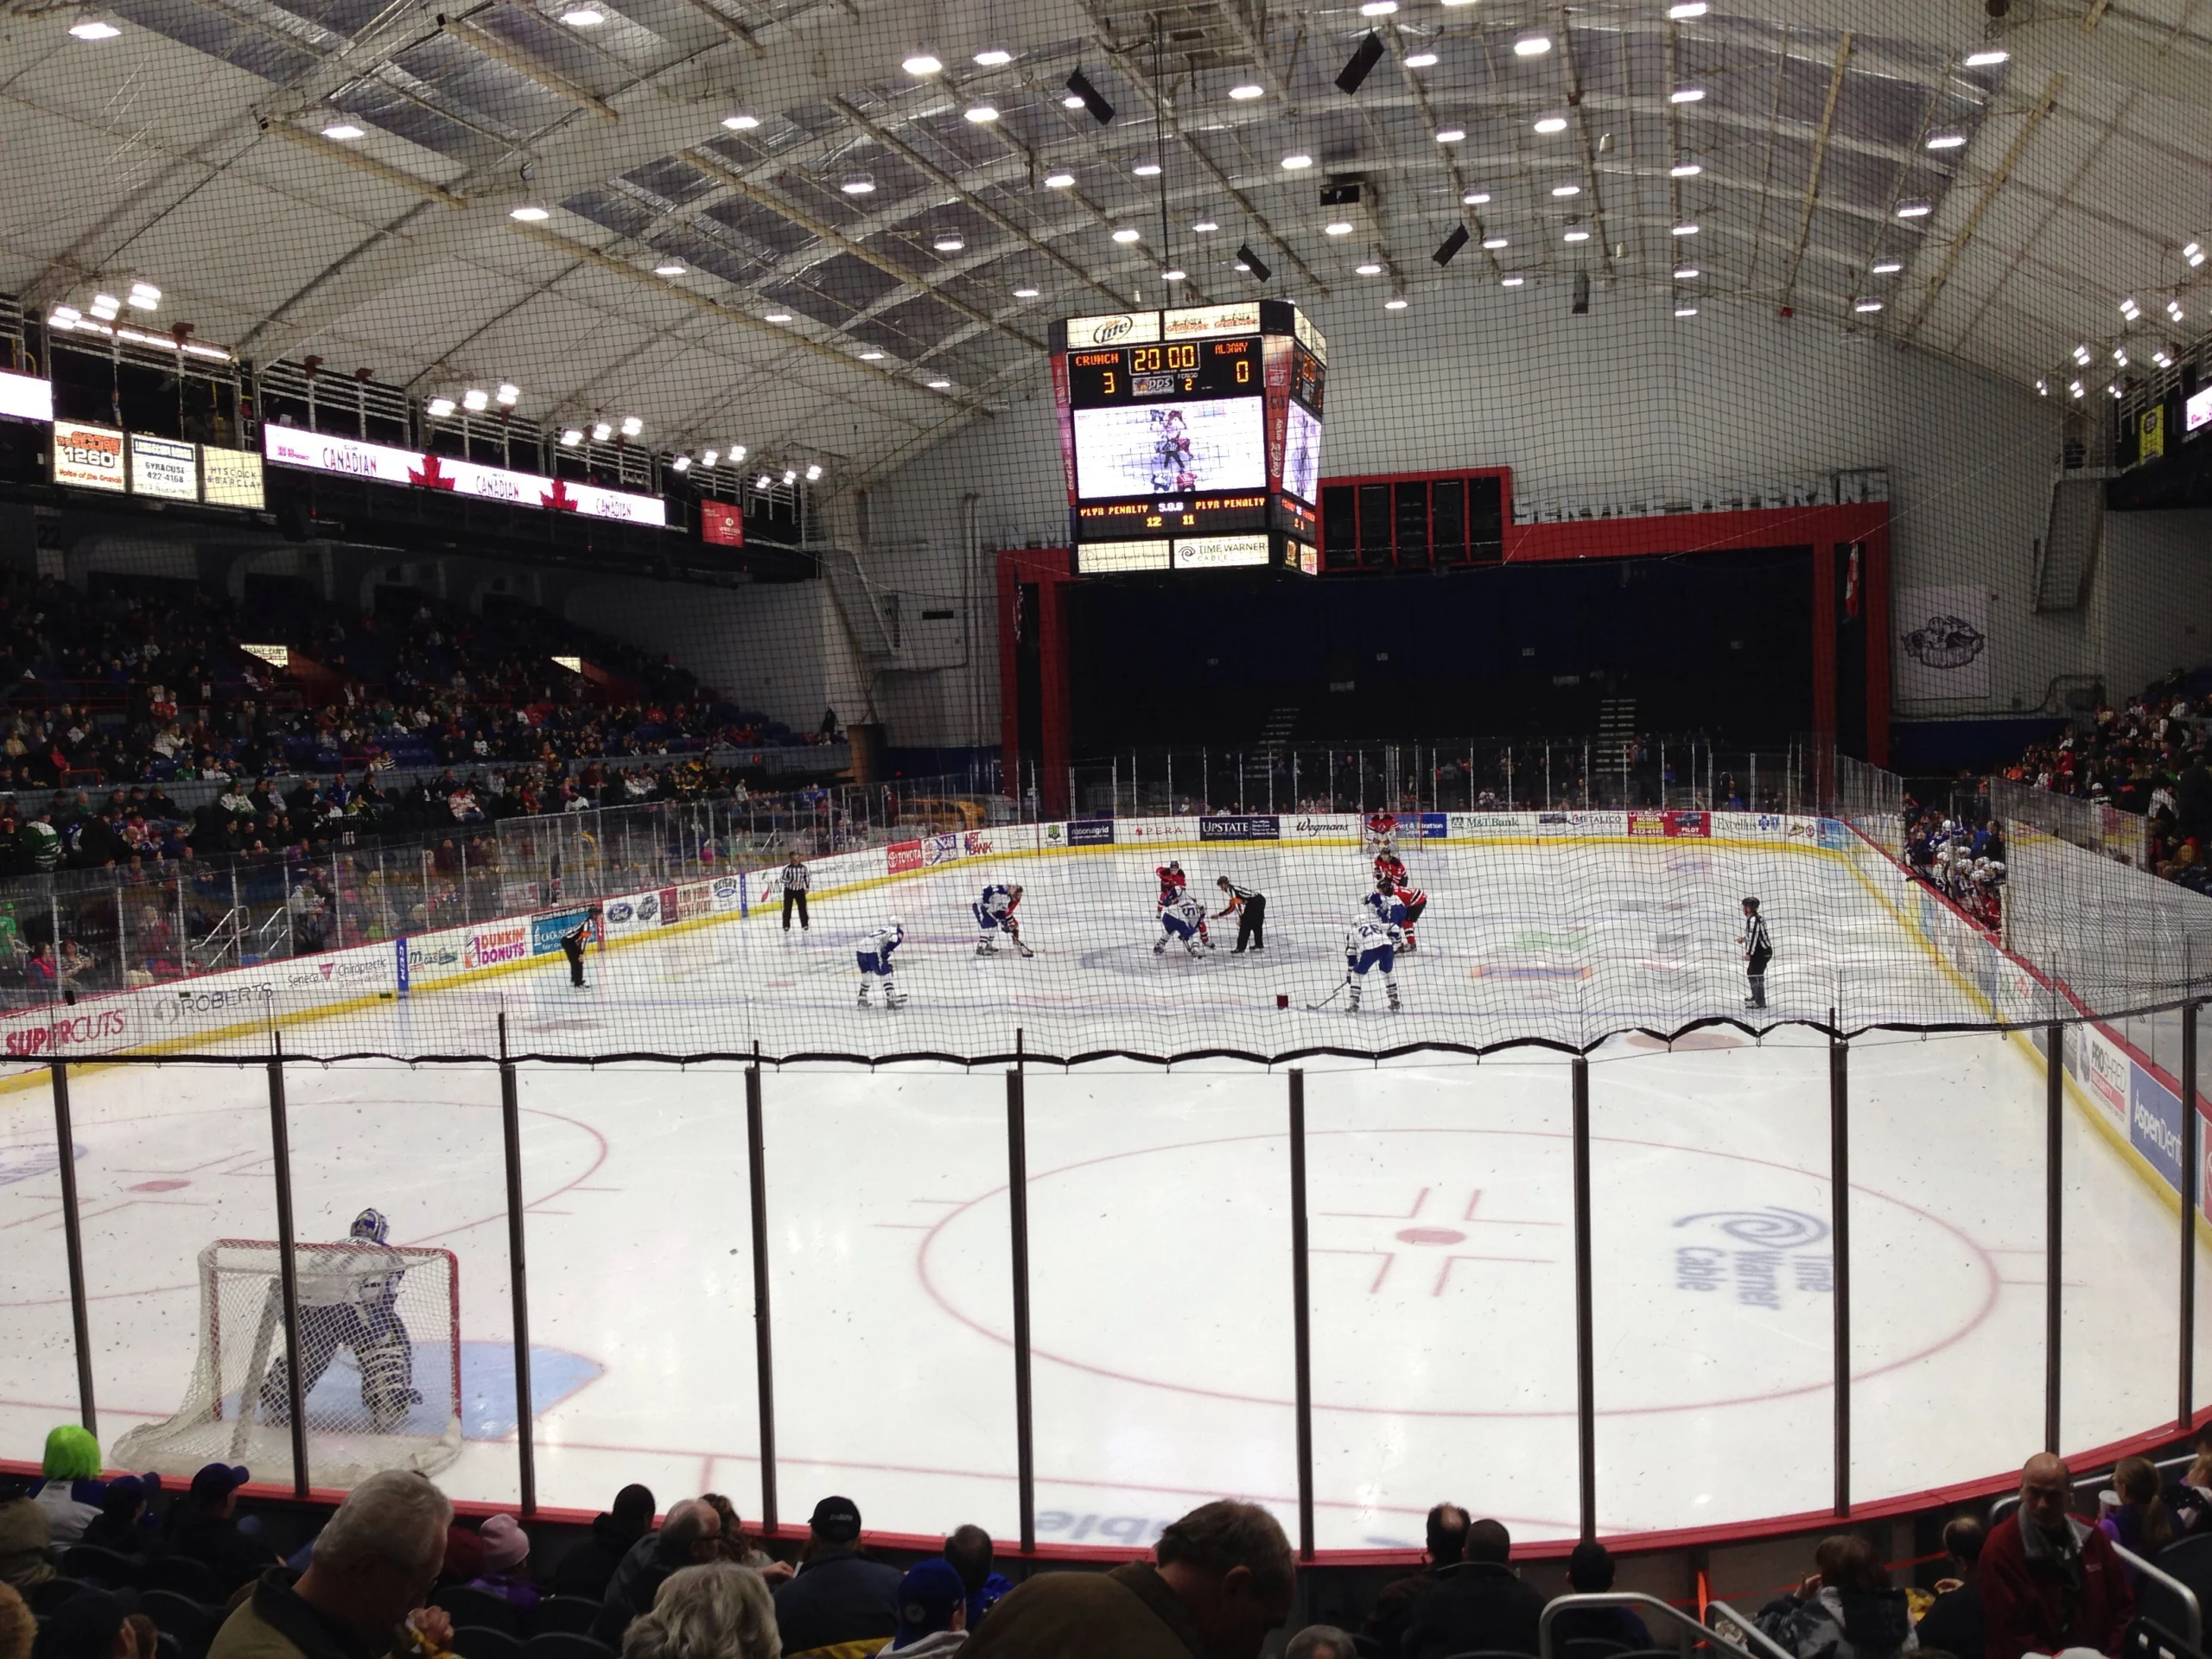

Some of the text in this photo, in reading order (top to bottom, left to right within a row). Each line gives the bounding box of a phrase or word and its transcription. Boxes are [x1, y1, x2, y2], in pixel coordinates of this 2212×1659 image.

[1076, 353, 1119, 366] CRUNCH
[1236, 360, 1249, 383] 0
[1103, 372, 1116, 394] 3
[1148, 378, 1171, 392] pps
[1185, 378, 1192, 391] 2
[72, 431, 122, 455] SCORE
[63, 446, 116, 468] 1260
[322, 447, 378, 476] CANADIAN
[145, 461, 185, 474] SYRACUSE
[210, 466, 257, 480] HISCOCK
[476, 475, 519, 500] CANADIAN
[596, 497, 632, 518] CANADIAN
[1108, 505, 1148, 515] PENALTY
[1224, 498, 1266, 508] PENALTY
[1147, 517, 1163, 527] 12
[1182, 515, 1195, 525] 11
[1198, 543, 1267, 554] TIME WARNER
[1296, 817, 1349, 836] Wegmans
[1491, 817, 1520, 827] Bank
[1716, 817, 1757, 831] Excellus
[1071, 826, 1109, 836] nationalgrid
[898, 849, 922, 864] TOYOTA
[482, 942, 525, 965] DONUTS
[338, 958, 388, 976] Chiropractic
[287, 972, 320, 988] Seneca
[180, 982, 273, 1016] ROBERTS
[4, 1008, 125, 1056] SUPERCUTS
[2133, 1088, 2183, 1166] AspenDent
